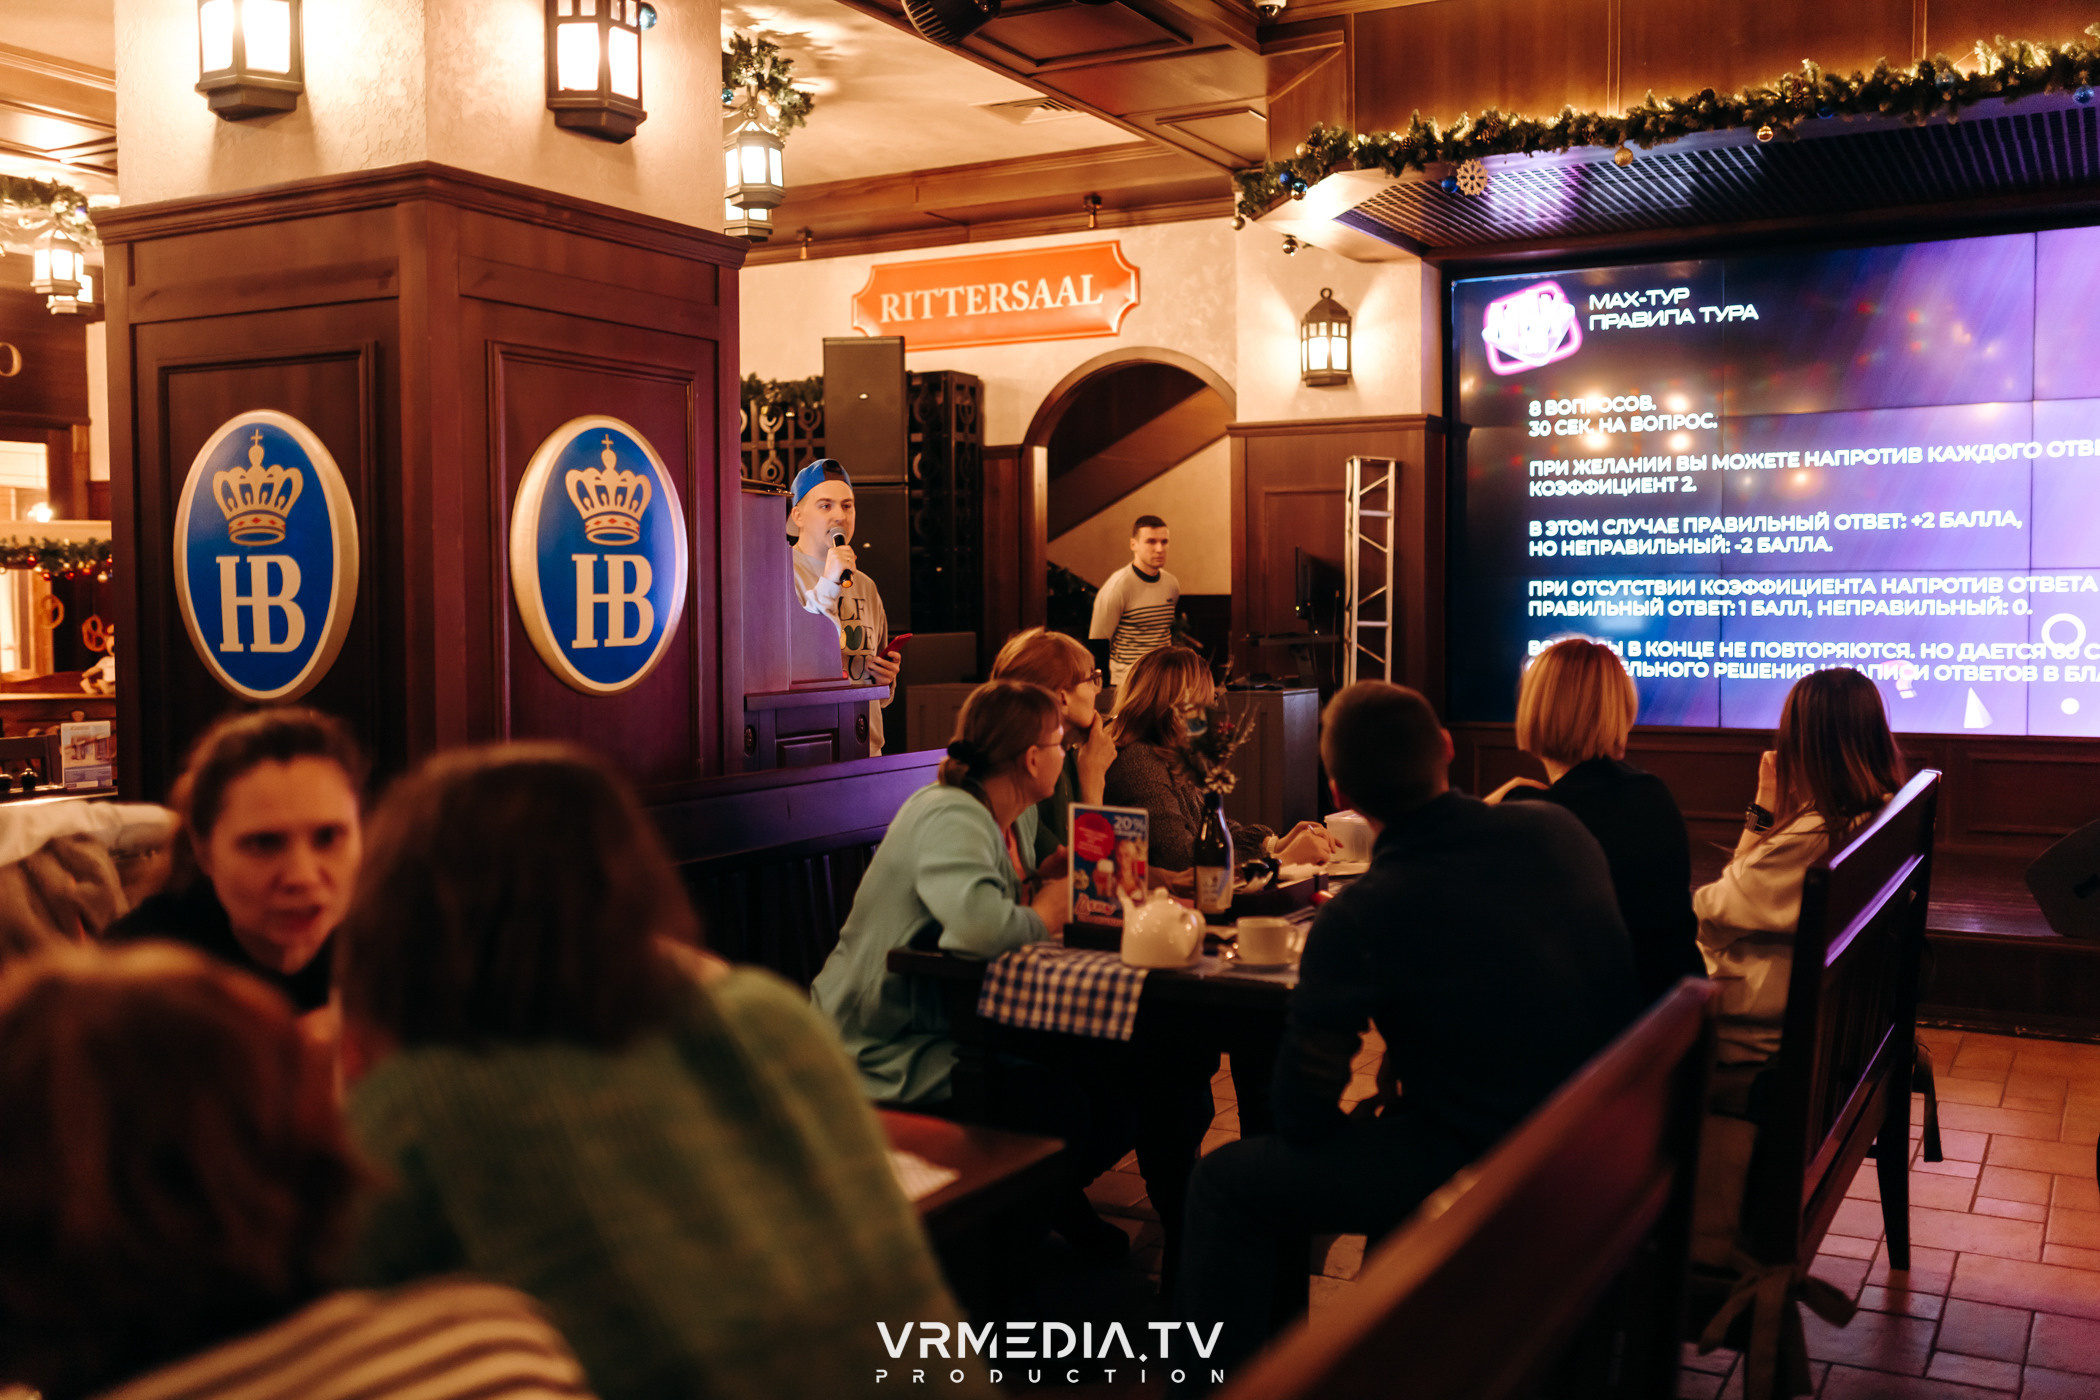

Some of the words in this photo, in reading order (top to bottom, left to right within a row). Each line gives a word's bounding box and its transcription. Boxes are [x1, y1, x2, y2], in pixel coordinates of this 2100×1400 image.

[880, 274, 1104, 323] RITTERSAAL
[1589, 287, 1690, 311] МАХ-ТУР
[1589, 308, 1696, 331] ПРАВИЛА
[1699, 304, 1759, 323] ТУРА
[1528, 400, 1542, 417] 8
[1544, 394, 1657, 416] ВОПРОСОВ.
[1528, 420, 1552, 437] 30
[1554, 418, 1594, 436] СЕК.
[1599, 416, 1627, 434] НА
[1630, 412, 1718, 432] ВОПРОС.
[1528, 459, 1569, 477] ПРИ
[1572, 455, 1672, 475] ЖЕЛАНИИ
[1676, 454, 1707, 472] ВЫ
[1711, 451, 1801, 471] МОЖЕТЕ
[1804, 446, 1924, 468] НАПРОТИВ
[1927, 441, 2043, 464] КАЖДОГО
[1528, 476, 1679, 497] КОЭФФИЦИЕНТ
[1680, 475, 1698, 492] 2.
[1528, 520, 1543, 537] В
[1545, 519, 1599, 537] ЭТОМ
[1602, 517, 1680, 536] СЛУЧАЕ
[1682, 511, 1830, 535] ПРАВИЛЬНЫЙ
[1834, 512, 1907, 531] ОТВЕТ:
[1911, 511, 1936, 529] +2
[1939, 510, 2023, 529] БАЛЛА,
[1528, 540, 1559, 557] НО
[1560, 534, 1732, 556] НЕПРАВИЛЬНЫЙ:
[1733, 536, 1754, 554] -2
[1756, 535, 1834, 554] БАЛЛА.
[1528, 580, 1569, 597] ПРИ
[1571, 579, 1697, 597] ОТСУТСТВИИ
[1700, 578, 1877, 598] КОЭФФИЦИЕНТА
[1880, 576, 2004, 595] НАПРОТИВ
[2007, 575, 2099, 594] ОТВЕТА
[216, 554, 306, 653] HB
[571, 553, 655, 649] HB
[838, 596, 865, 620] LF
[1528, 597, 1664, 617] ПРАВИЛЬНЫЙ
[1667, 600, 1736, 617] ОТВЕТ:
[1738, 600, 1747, 617] 1
[1751, 600, 1814, 619] БАЛЛ,
[1817, 596, 2009, 617] НЕПРАВИЛЬНЫЙ:
[1628, 640, 1642, 657] В
[1645, 641, 1714, 660] КОНЦЕ
[1719, 641, 1747, 658] НЕ
[1751, 641, 1915, 660] ПОВТОРЯЮТСЯ.
[1920, 643, 1954, 660] НО
[1957, 643, 2046, 662] ДАЕТСЯ
[1714, 662, 1815, 679] РЕШЕНИЯ
[1843, 663, 1930, 680] АПИСИ
[1934, 665, 2038, 682] ОТВЕТОВ
[2043, 665, 2060, 682] В
[2064, 665, 2100, 682] БЛ
